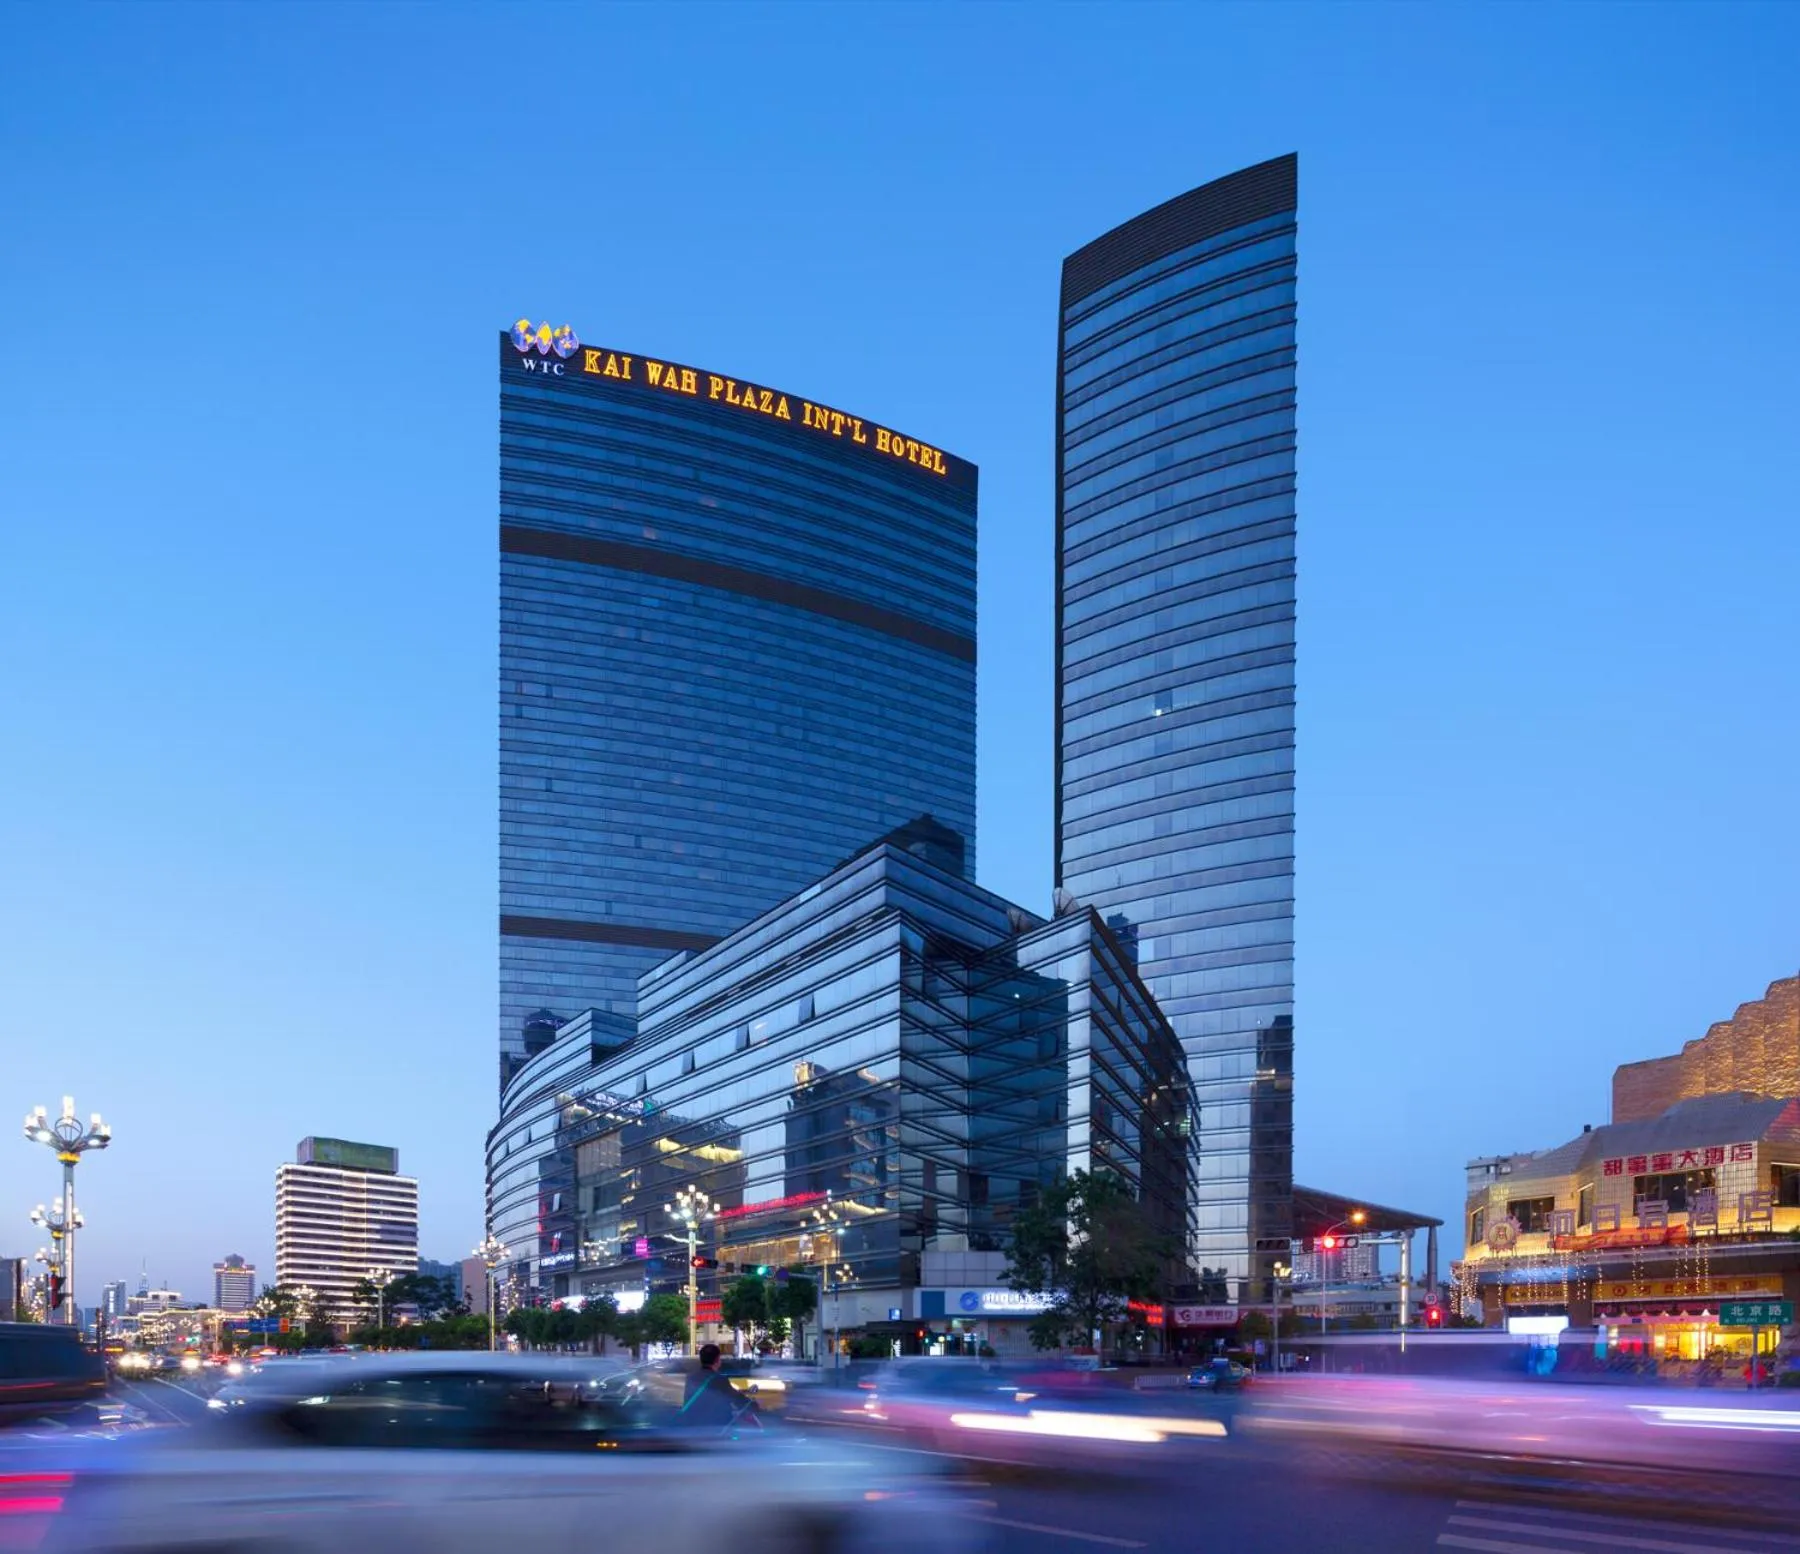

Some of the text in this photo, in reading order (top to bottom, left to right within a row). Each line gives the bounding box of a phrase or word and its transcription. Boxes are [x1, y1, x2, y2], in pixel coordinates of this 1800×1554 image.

[522, 358, 565, 376] WTC
[584, 350, 947, 475] KAI WAH PLAZA INT'L HOTEL
[1603, 1144, 1752, 1176] 甜蜜蜜大酒店
[1731, 1304, 1782, 1316] 北京路
